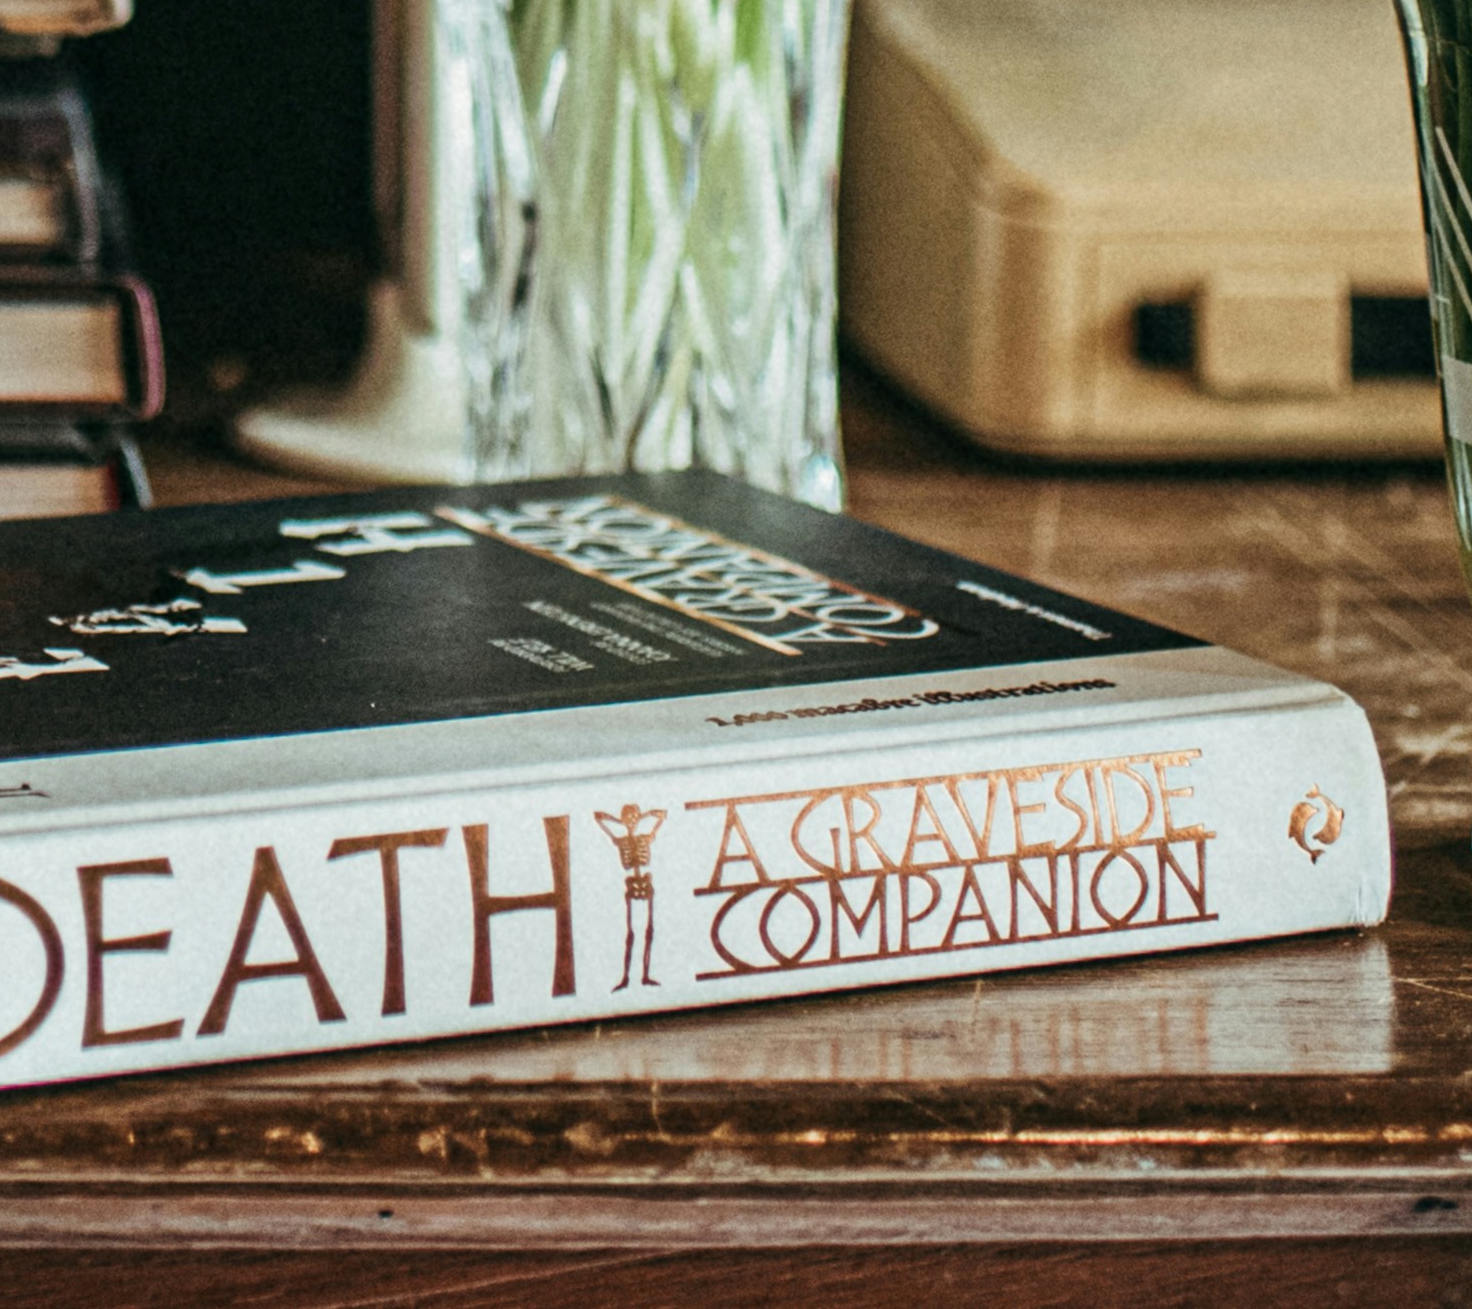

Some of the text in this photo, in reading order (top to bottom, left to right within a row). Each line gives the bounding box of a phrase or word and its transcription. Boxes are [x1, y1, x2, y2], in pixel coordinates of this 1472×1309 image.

[786, 697, 920, 719] macabre
[912, 678, 1118, 706] illustrations
[707, 751, 1207, 890] A GRAVESIDE
[709, 836, 1209, 971] COMPANION
